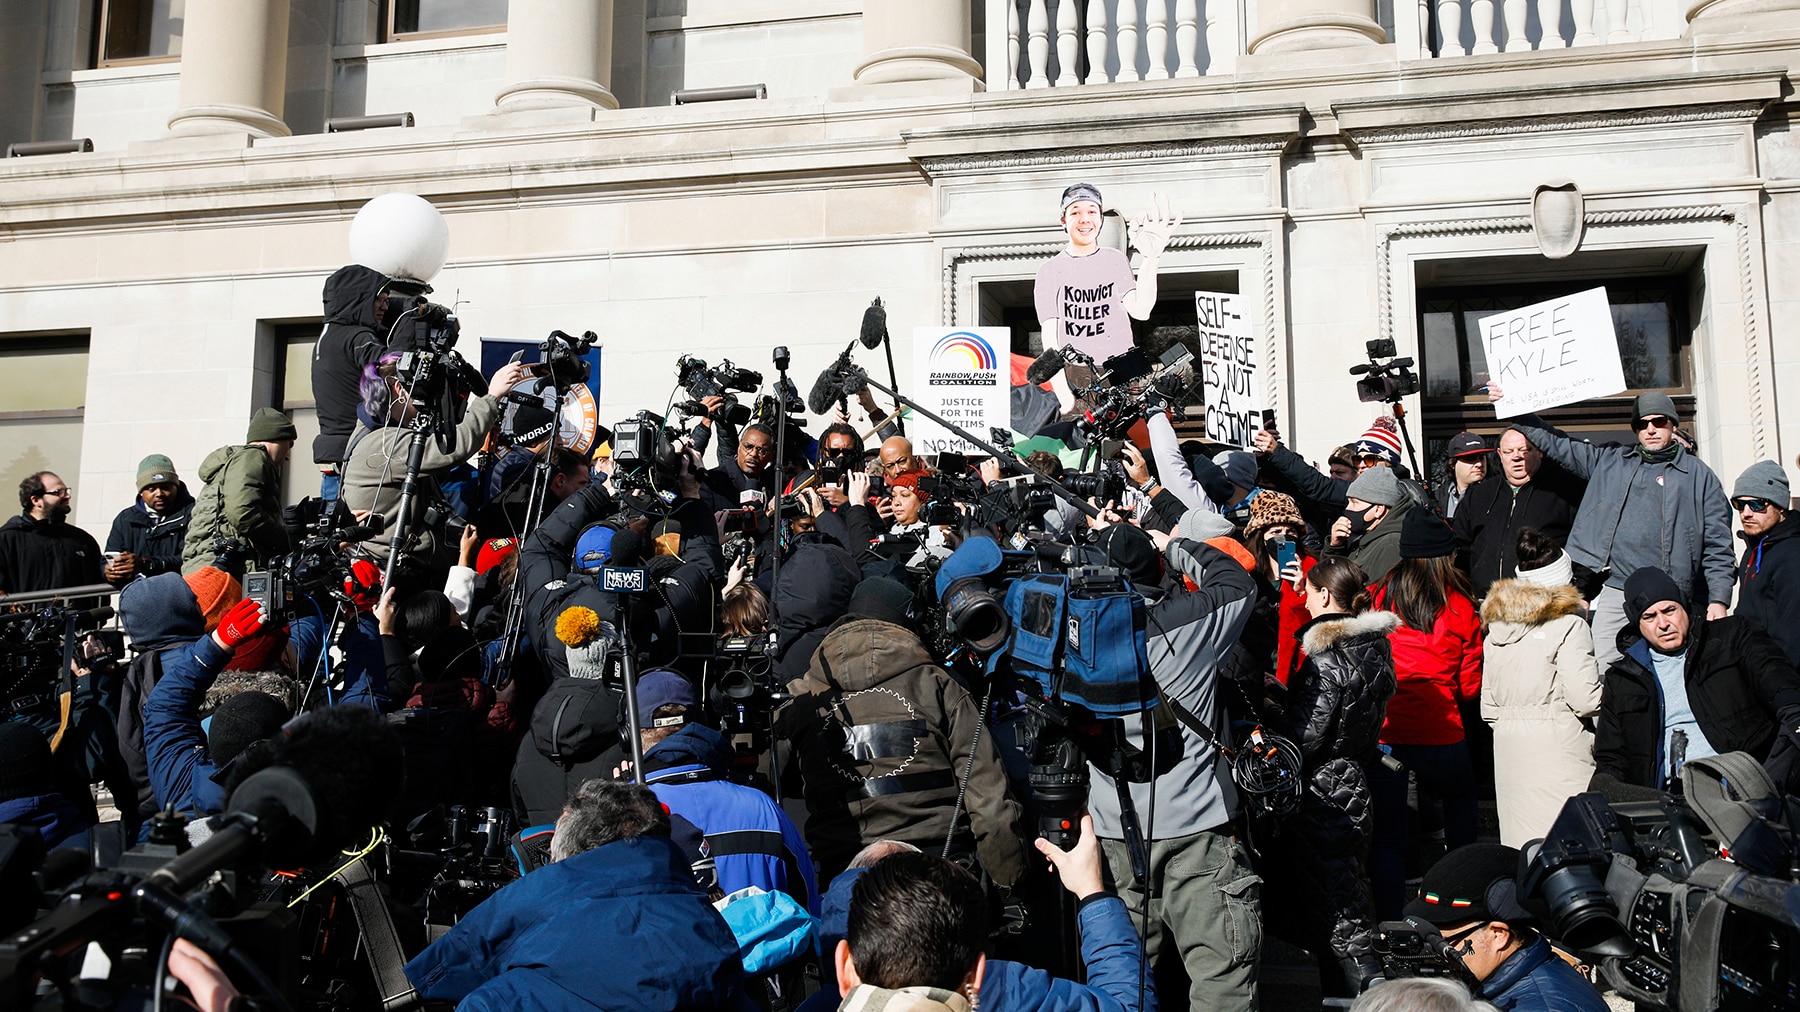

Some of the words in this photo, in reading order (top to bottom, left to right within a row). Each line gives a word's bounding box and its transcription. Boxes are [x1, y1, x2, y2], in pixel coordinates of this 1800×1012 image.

[1197, 296, 1241, 329] SELF-
[1065, 320, 1105, 337] KYLE
[1489, 303, 1573, 354] FREE
[1200, 331, 1256, 369] DEFENSE
[1498, 339, 1578, 384] KYLE
[1202, 360, 1220, 389] IS
[1226, 363, 1253, 397] NOT
[940, 398, 984, 406] JUSTICE
[1219, 382, 1231, 412] A
[1520, 391, 1538, 403] USA
[940, 409, 961, 417] FOR
[964, 409, 984, 417] THE
[1206, 404, 1263, 452] CRIME
[607, 571, 641, 581] NEWS
[607, 580, 641, 589] NATION
